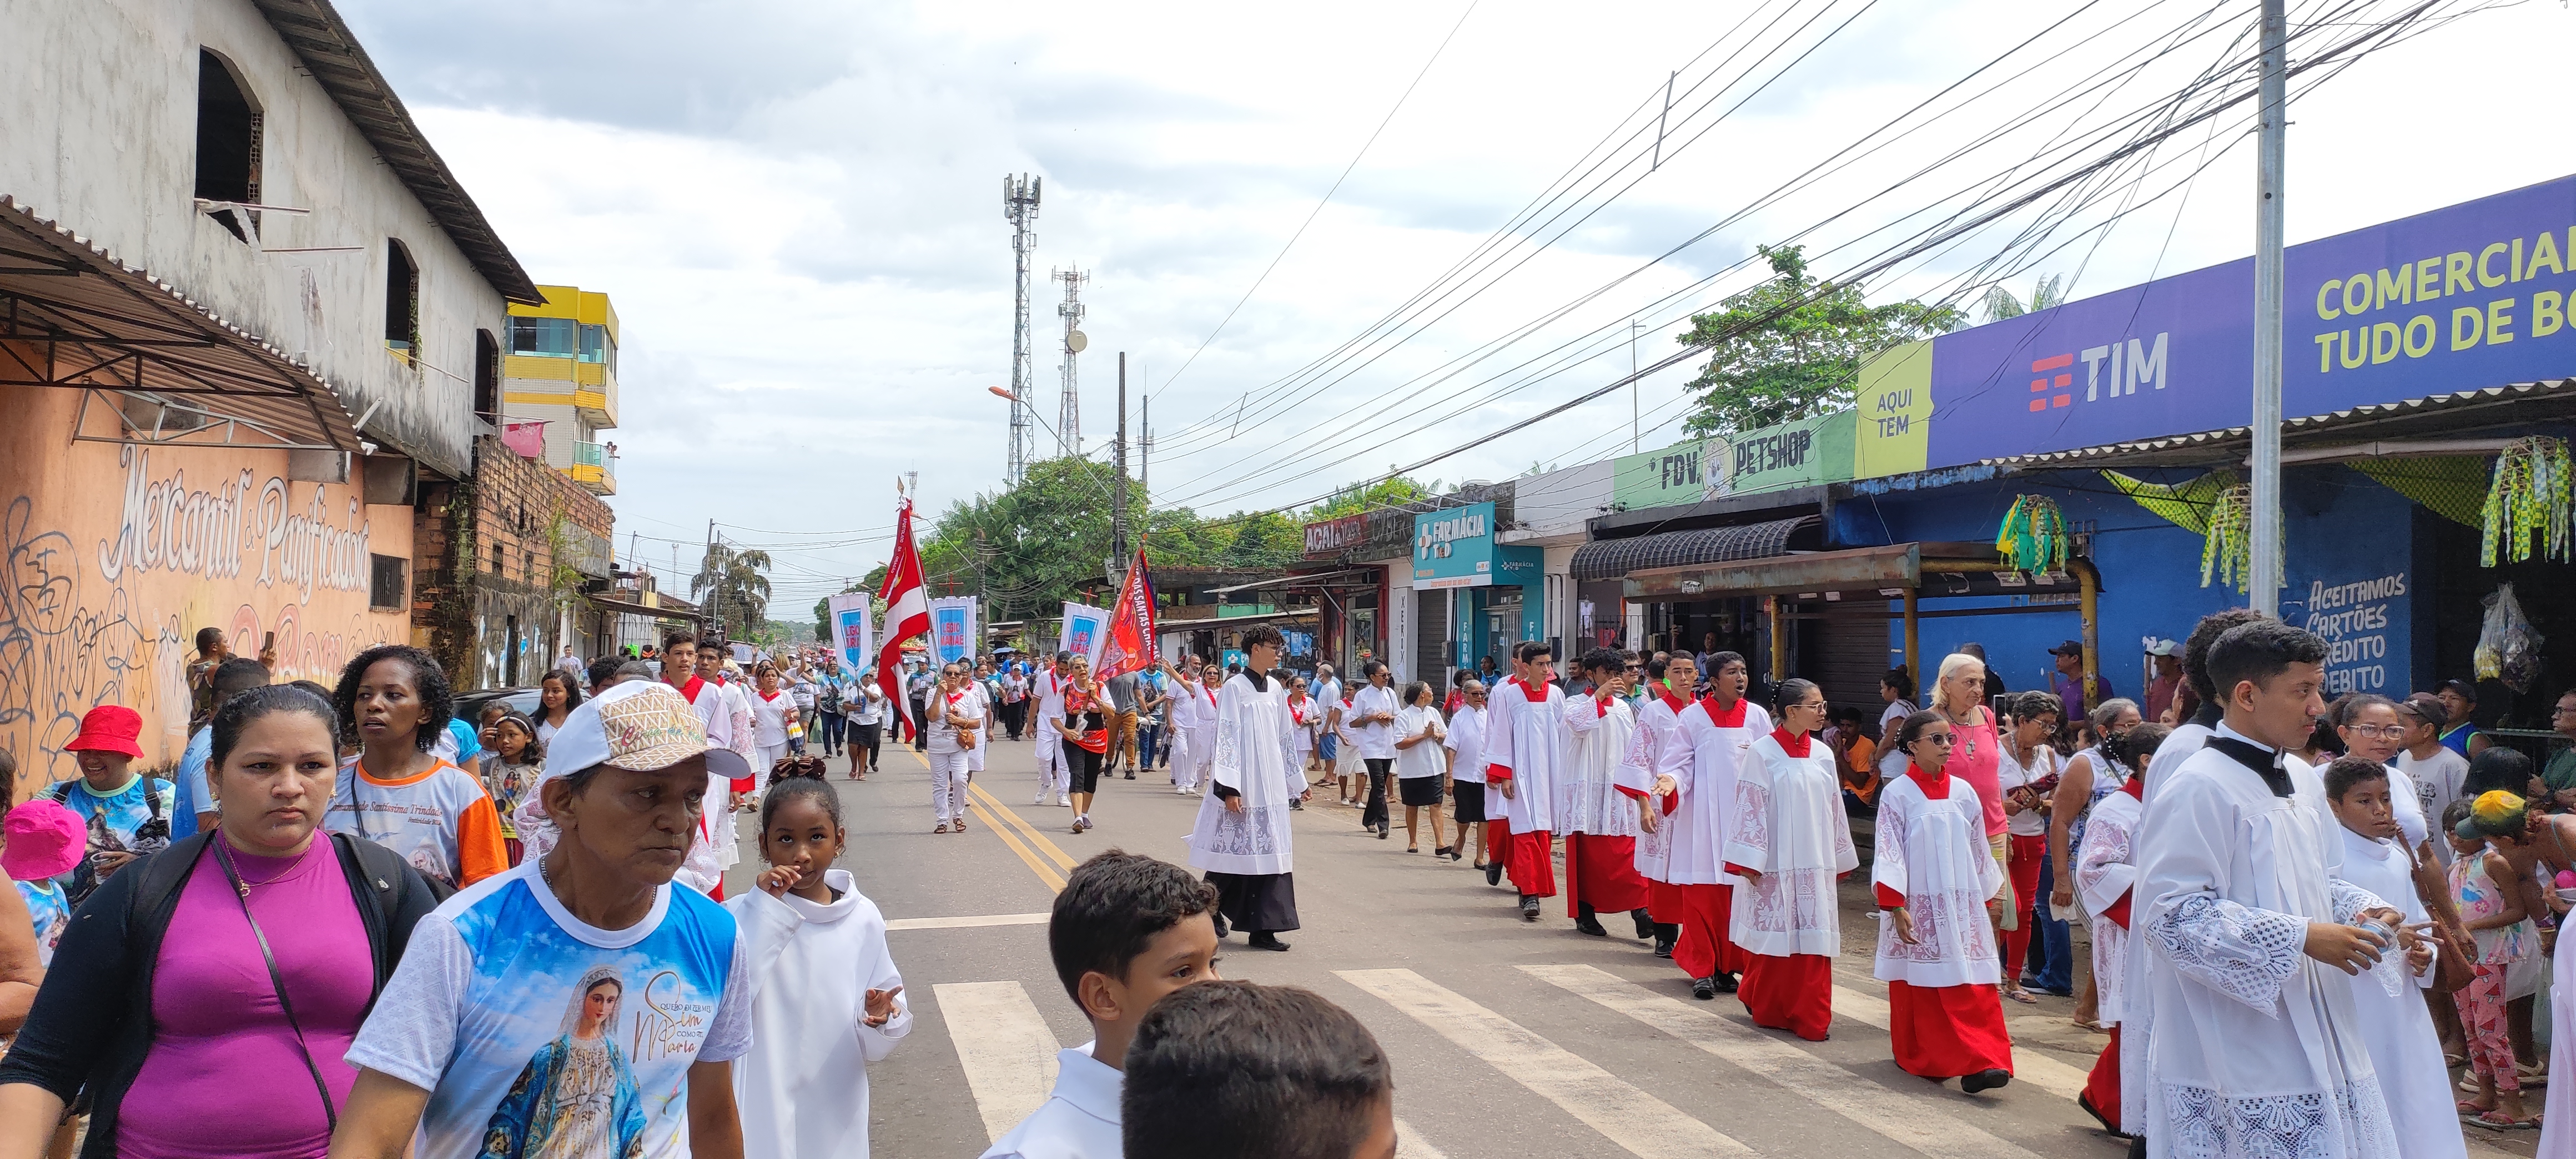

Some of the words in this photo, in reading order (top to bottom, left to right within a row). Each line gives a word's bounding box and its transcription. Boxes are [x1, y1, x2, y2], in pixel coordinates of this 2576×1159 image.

[2315, 315, 2436, 373] TUDO
[2451, 298, 2515, 351] DE
[2532, 290, 2576, 337] B
[2081, 332, 2169, 402] TIM
[1876, 388, 1913, 414] AQUI
[1878, 414, 1909, 439] TEM
[1736, 430, 1810, 476] PETSHOP
[98, 435, 253, 583] Mercantil
[245, 509, 254, 550] &
[255, 476, 370, 607] Panificadora
[1433, 508, 1486, 542] FARMÁCIA
[1433, 542, 1452, 558] T&D
[2309, 572, 2406, 612] ACEITAMOS
[1134, 594, 1150, 627] SANTAS
[2305, 603, 2387, 637] CARTÕES
[2323, 635, 2386, 667] RÉDITO
[370, 802, 409, 814] Santíssima
[410, 804, 443, 817] Trindade
